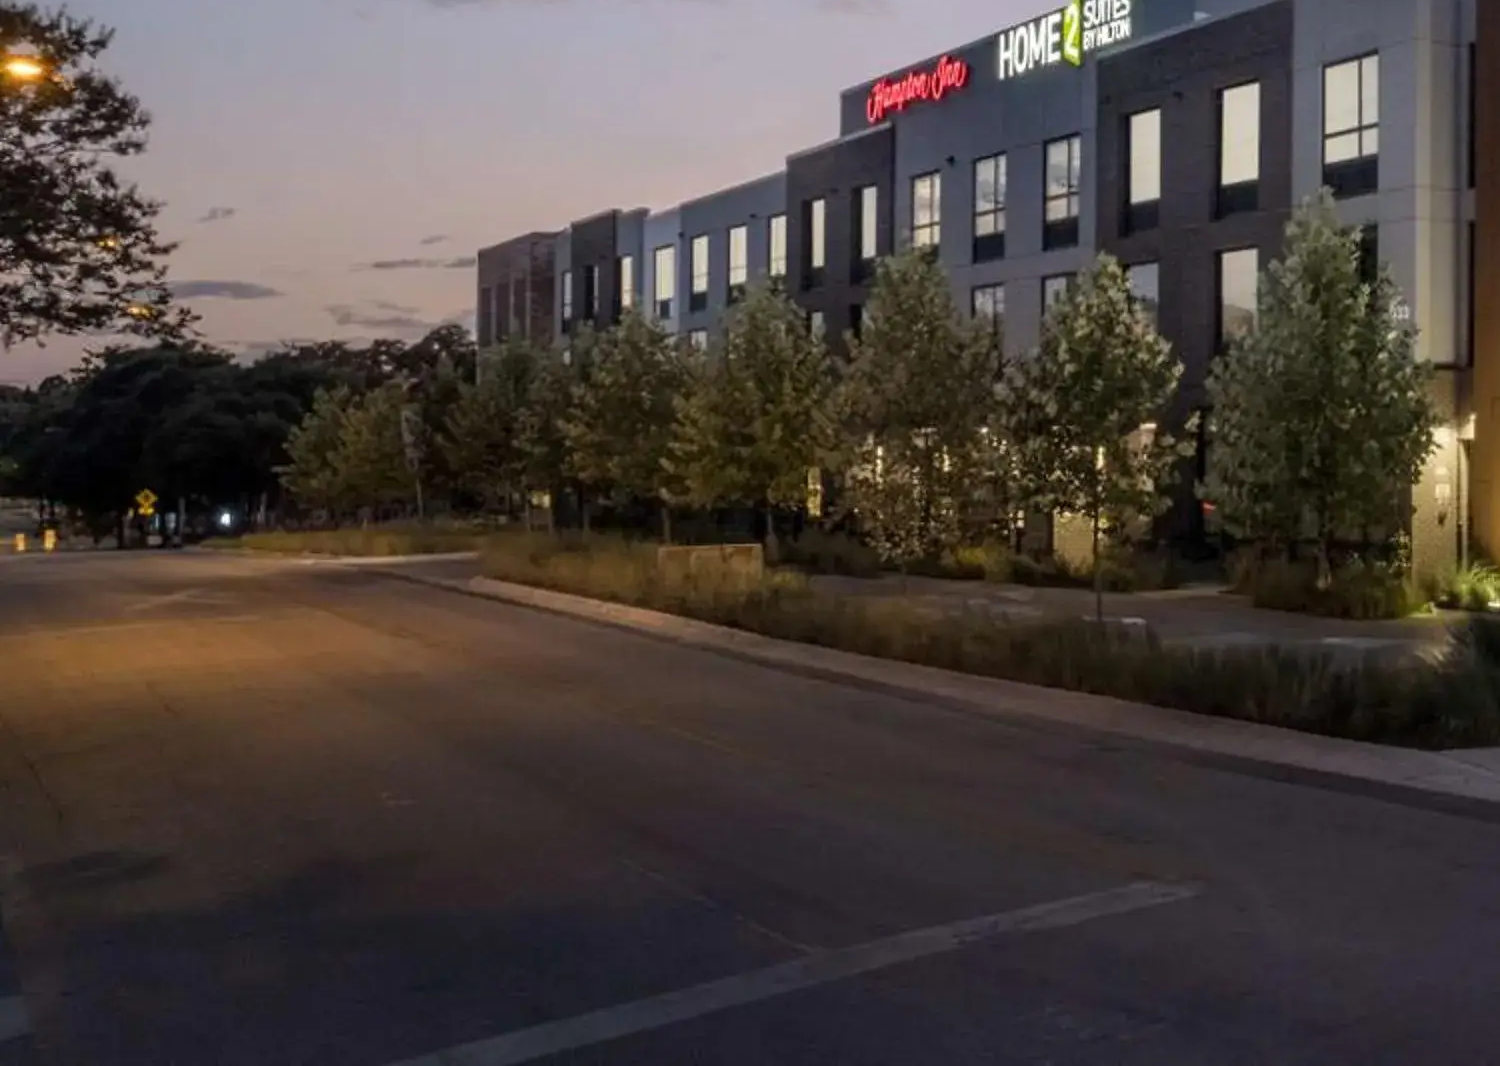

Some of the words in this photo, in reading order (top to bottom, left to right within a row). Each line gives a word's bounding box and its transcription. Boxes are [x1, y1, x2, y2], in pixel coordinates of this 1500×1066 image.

[998, 13, 1061, 80] HOME
[1064, 1, 1080, 60] 2
[1083, 30, 1096, 51] BY
[1097, 17, 1131, 46] HILTON
[867, 72, 931, 123] Hampton
[931, 55, 967, 101] Inn
